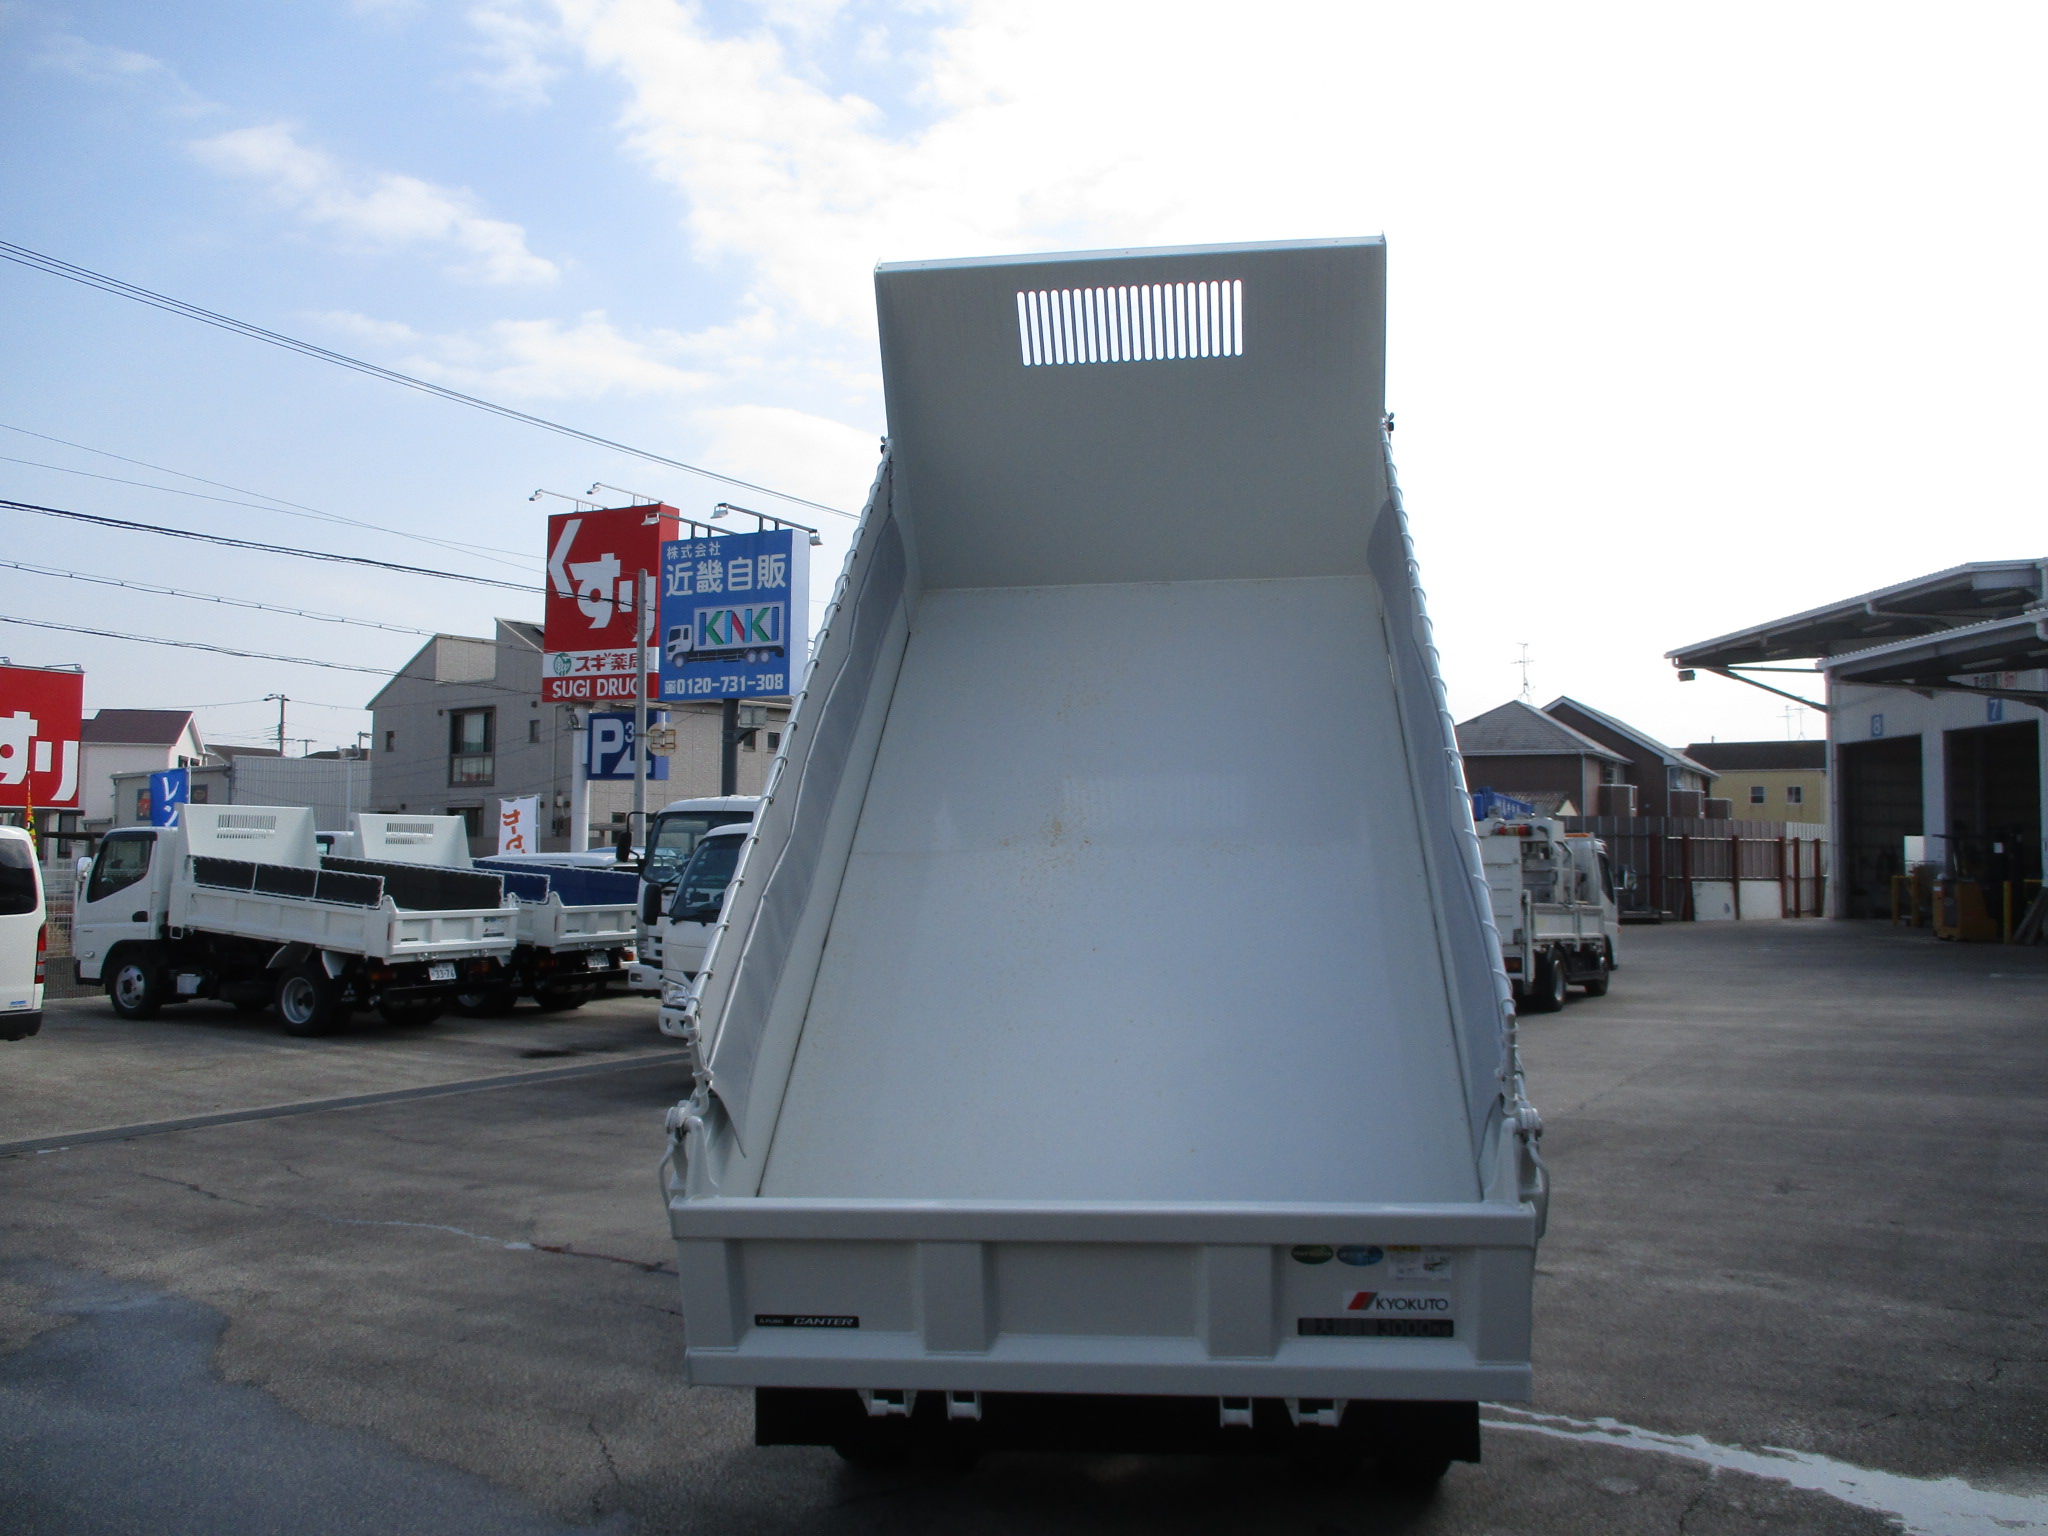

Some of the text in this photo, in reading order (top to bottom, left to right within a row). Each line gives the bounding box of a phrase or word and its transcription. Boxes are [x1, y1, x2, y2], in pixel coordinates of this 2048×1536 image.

[666, 542, 721, 560] 株式会社
[666, 554, 787, 598] 近畿自販
[552, 679, 590, 698] SUGI
[677, 673, 784, 695] 0120-731-308
[591, 718, 625, 774] P
[1376, 1298, 1449, 1311] KYOKUTO
[793, 1316, 854, 1326] CANTER
